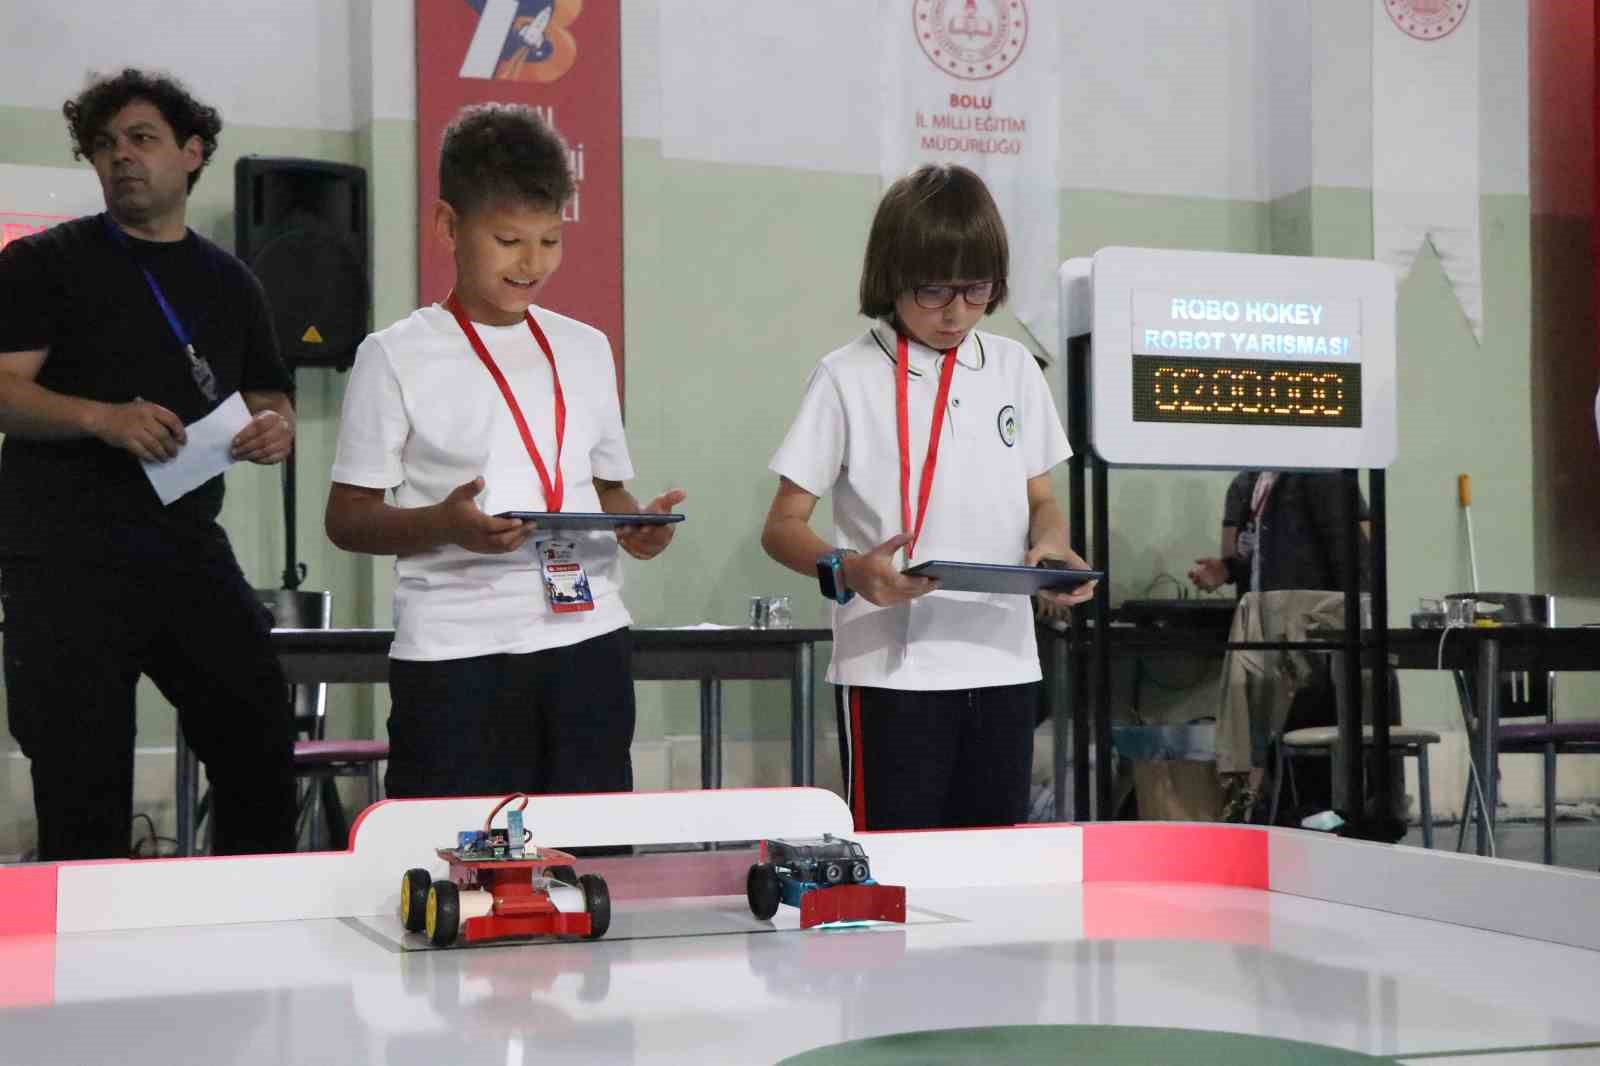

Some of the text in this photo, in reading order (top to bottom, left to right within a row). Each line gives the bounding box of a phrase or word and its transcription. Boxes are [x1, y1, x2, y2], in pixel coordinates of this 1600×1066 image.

[949, 93, 993, 110] BOLU
[1170, 298, 1324, 326] ROBO HOKEY
[1144, 329, 1226, 351] ROBOT
